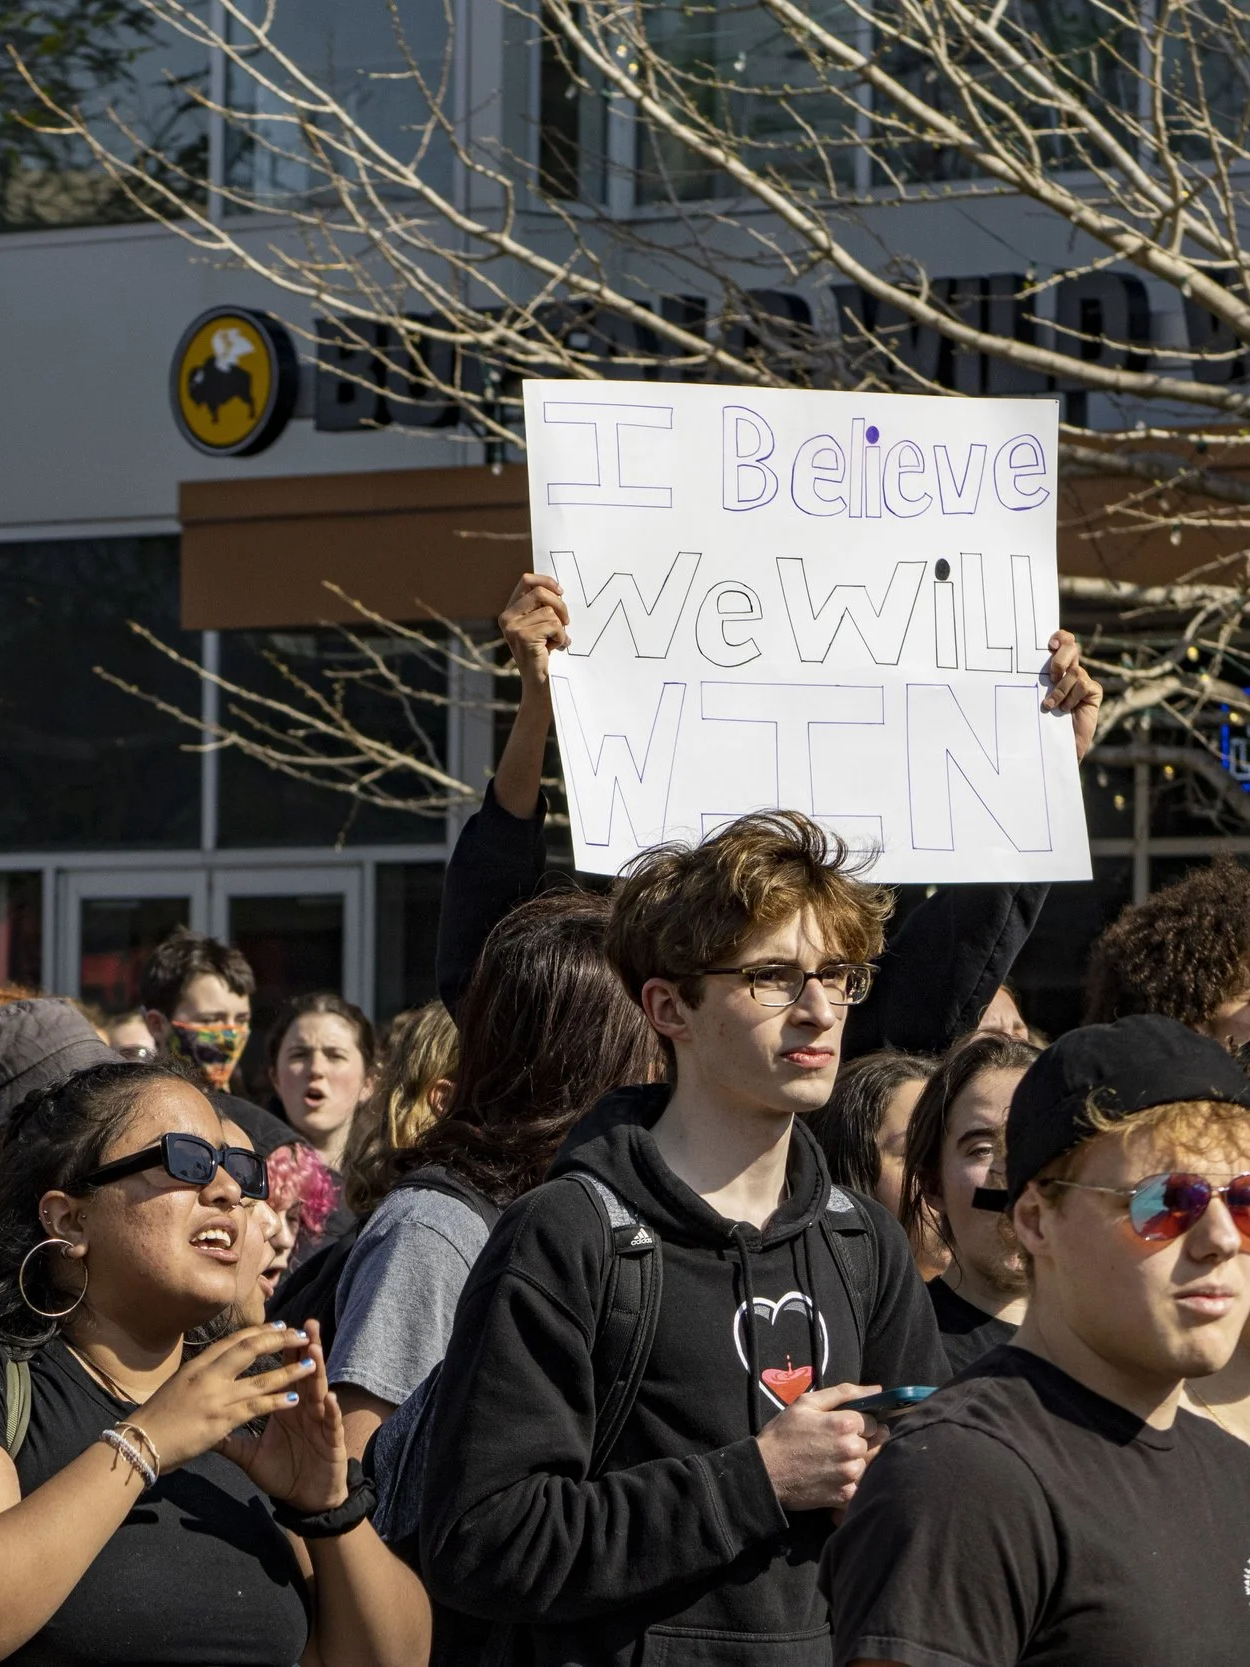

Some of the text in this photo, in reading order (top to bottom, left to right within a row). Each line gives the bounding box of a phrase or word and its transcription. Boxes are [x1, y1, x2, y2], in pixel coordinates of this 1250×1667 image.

[543, 401, 1050, 518] I Believe
[551, 674, 1053, 853] WIN
[631, 1237, 652, 1246] adidas
